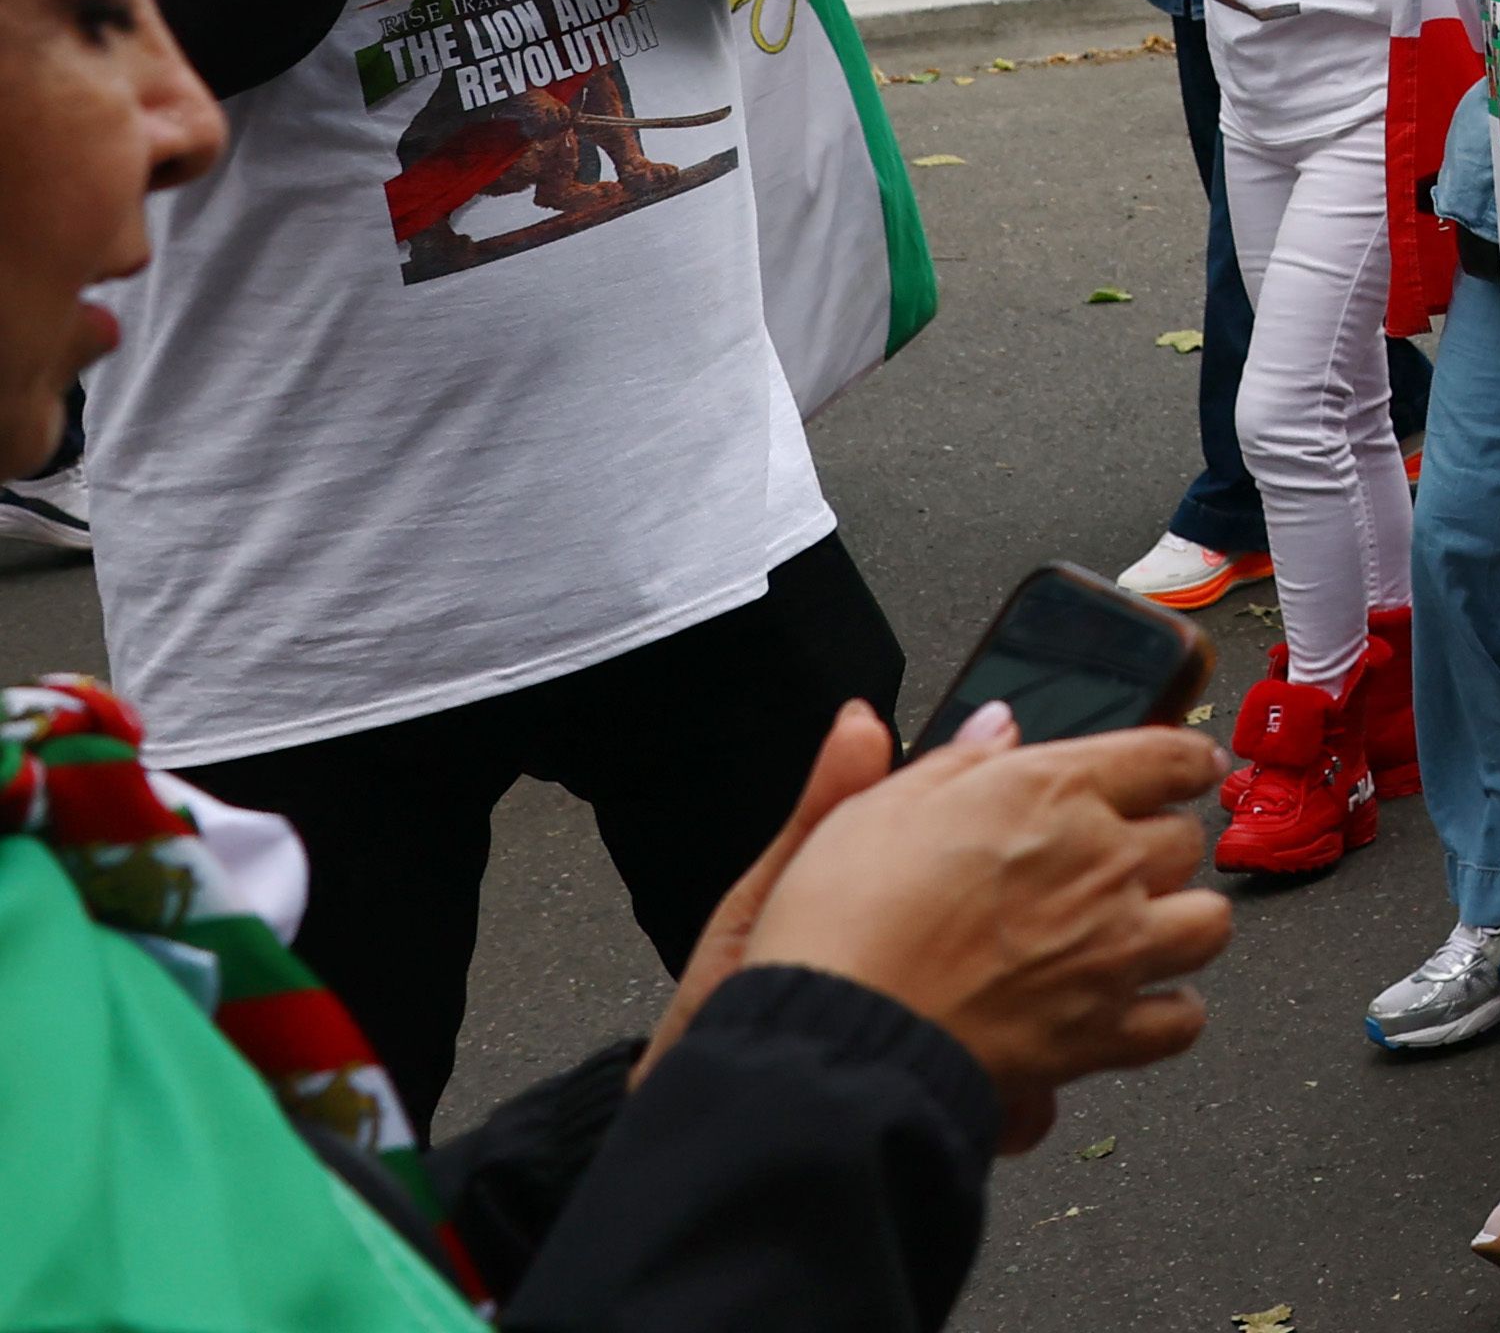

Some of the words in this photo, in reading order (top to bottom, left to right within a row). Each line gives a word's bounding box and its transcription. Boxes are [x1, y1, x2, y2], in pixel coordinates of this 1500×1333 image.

[379, 0, 444, 38] RISE
[383, 23, 462, 84] THE
[464, 0, 548, 60] LION
[455, 5, 659, 111] REVOLUTION
